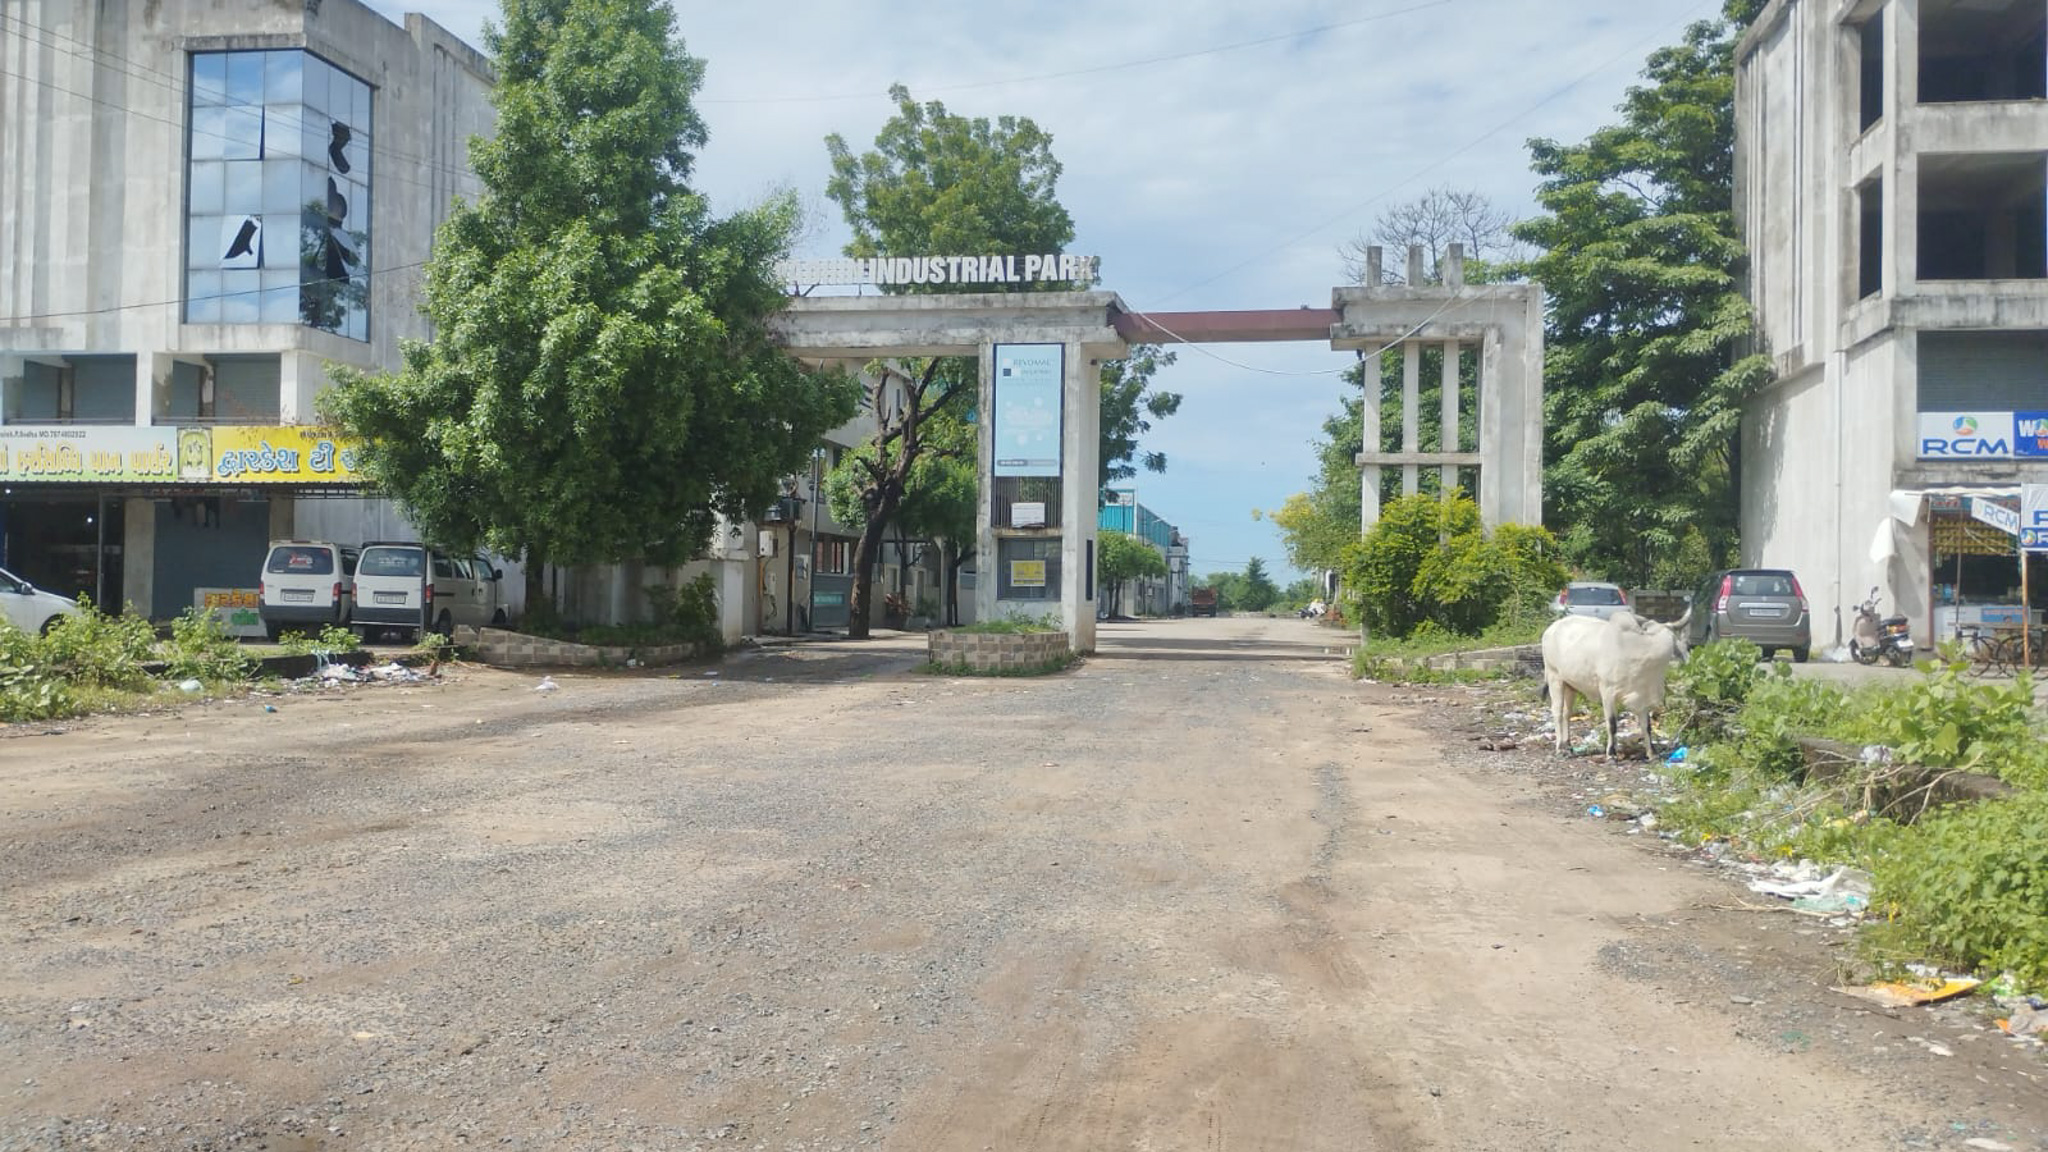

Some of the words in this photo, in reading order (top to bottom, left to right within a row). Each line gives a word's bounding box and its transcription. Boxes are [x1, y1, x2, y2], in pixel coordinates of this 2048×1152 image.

[868, 255, 1020, 285] INDUSTRIAL
[1922, 438, 2009, 455] RCM
[1984, 504, 2018, 531] RCM
